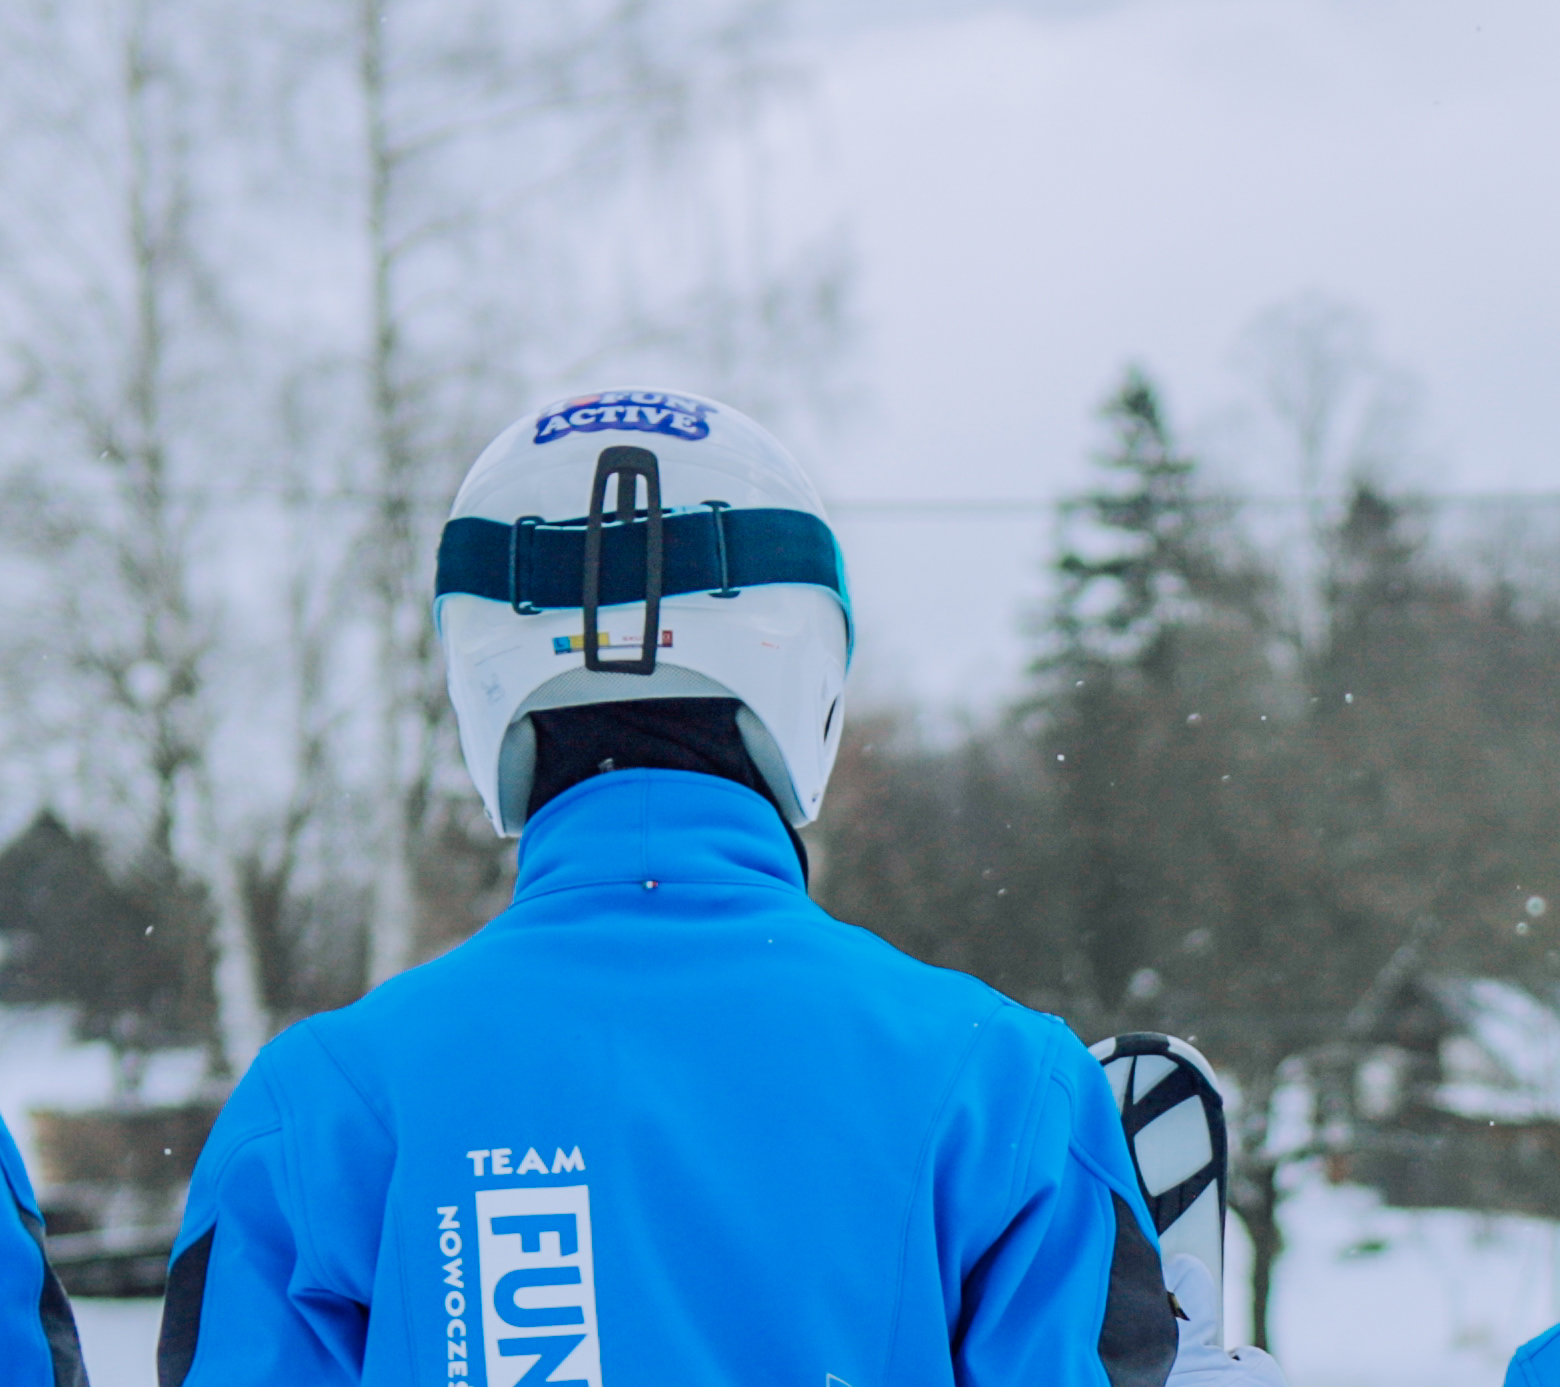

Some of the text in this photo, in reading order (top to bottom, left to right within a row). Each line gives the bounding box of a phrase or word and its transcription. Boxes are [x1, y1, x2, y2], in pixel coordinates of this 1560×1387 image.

[598, 391, 697, 413] FUN
[540, 404, 698, 437] ACTIVE
[466, 1146, 586, 1176] TEAM
